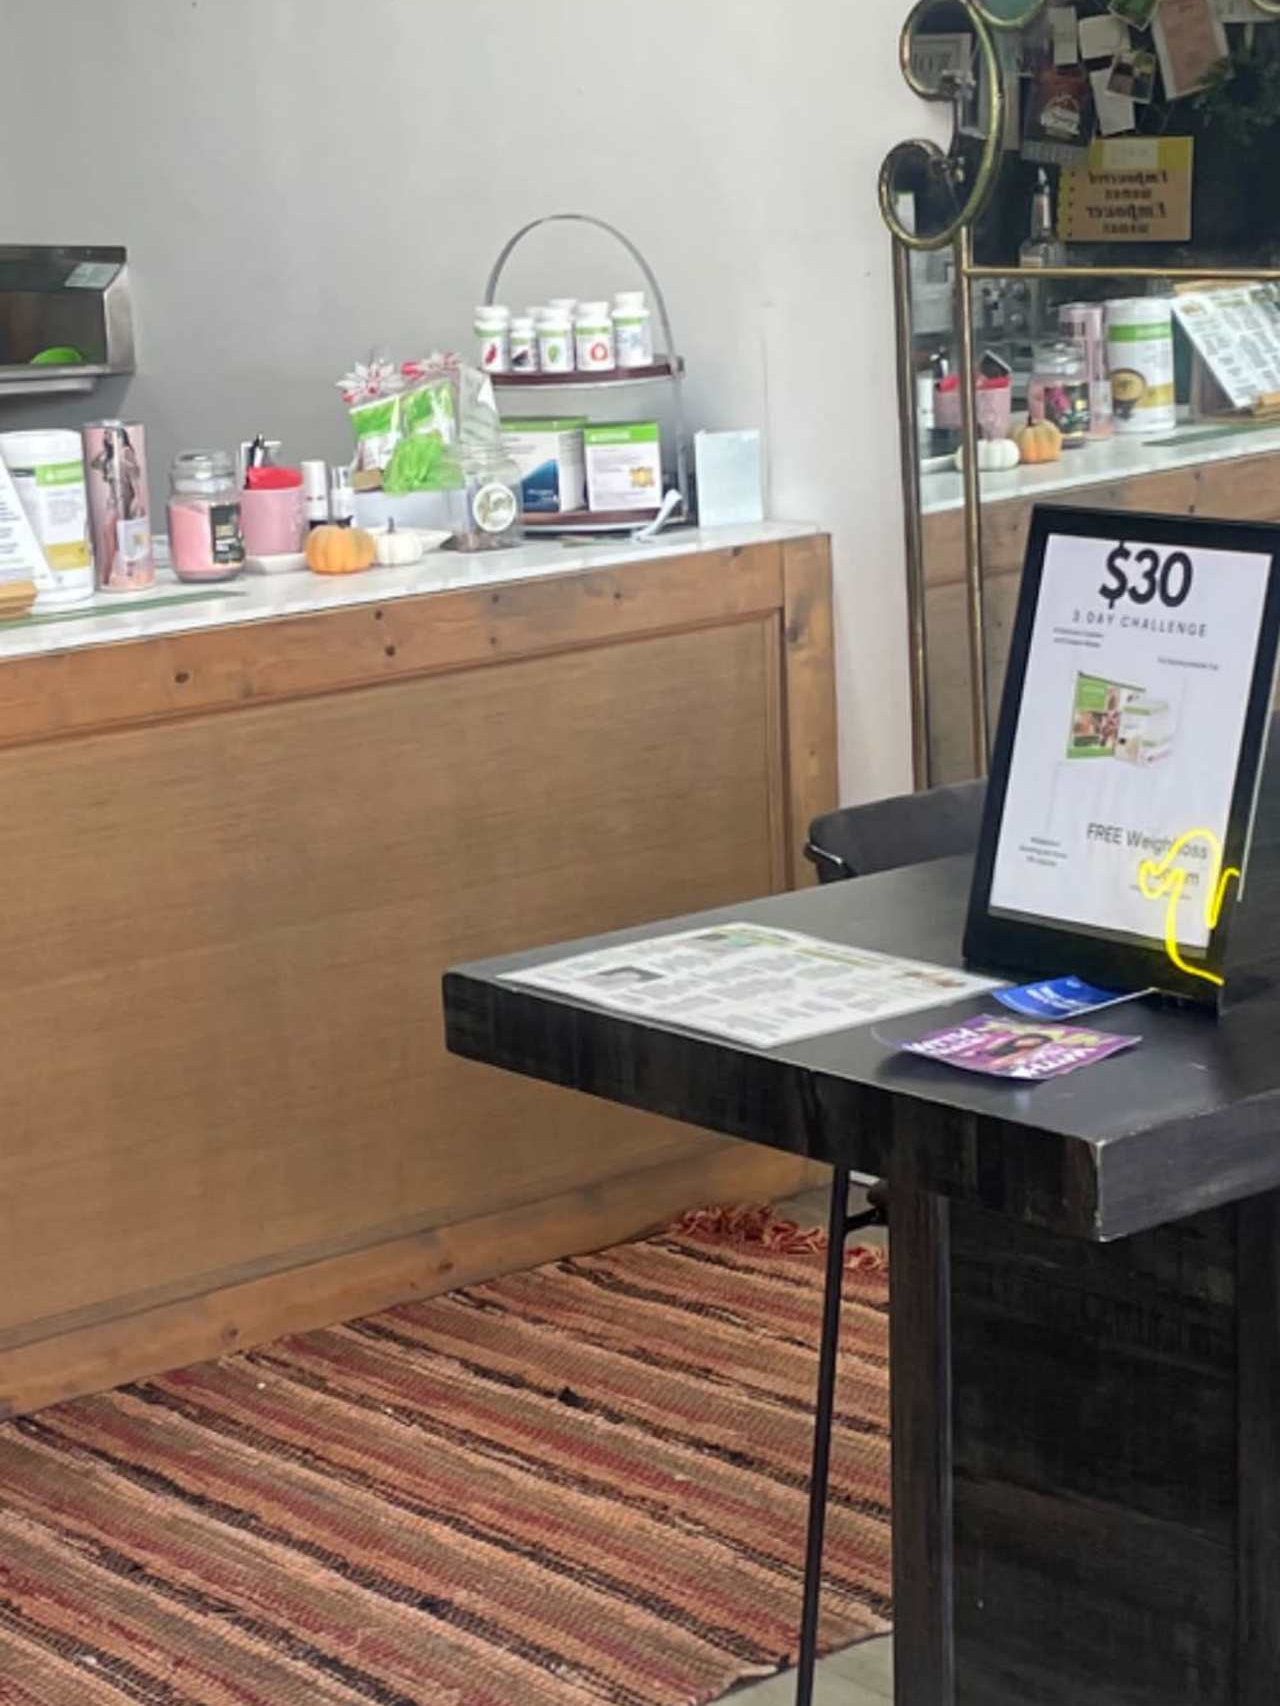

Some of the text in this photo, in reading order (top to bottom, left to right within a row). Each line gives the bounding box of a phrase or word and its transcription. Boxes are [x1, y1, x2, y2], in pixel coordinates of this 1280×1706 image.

[1099, 540, 1193, 609] $30
[1086, 610, 1116, 625] DAY
[1120, 615, 1208, 638] CHALLENGE
[1087, 822, 1123, 844] FREE
